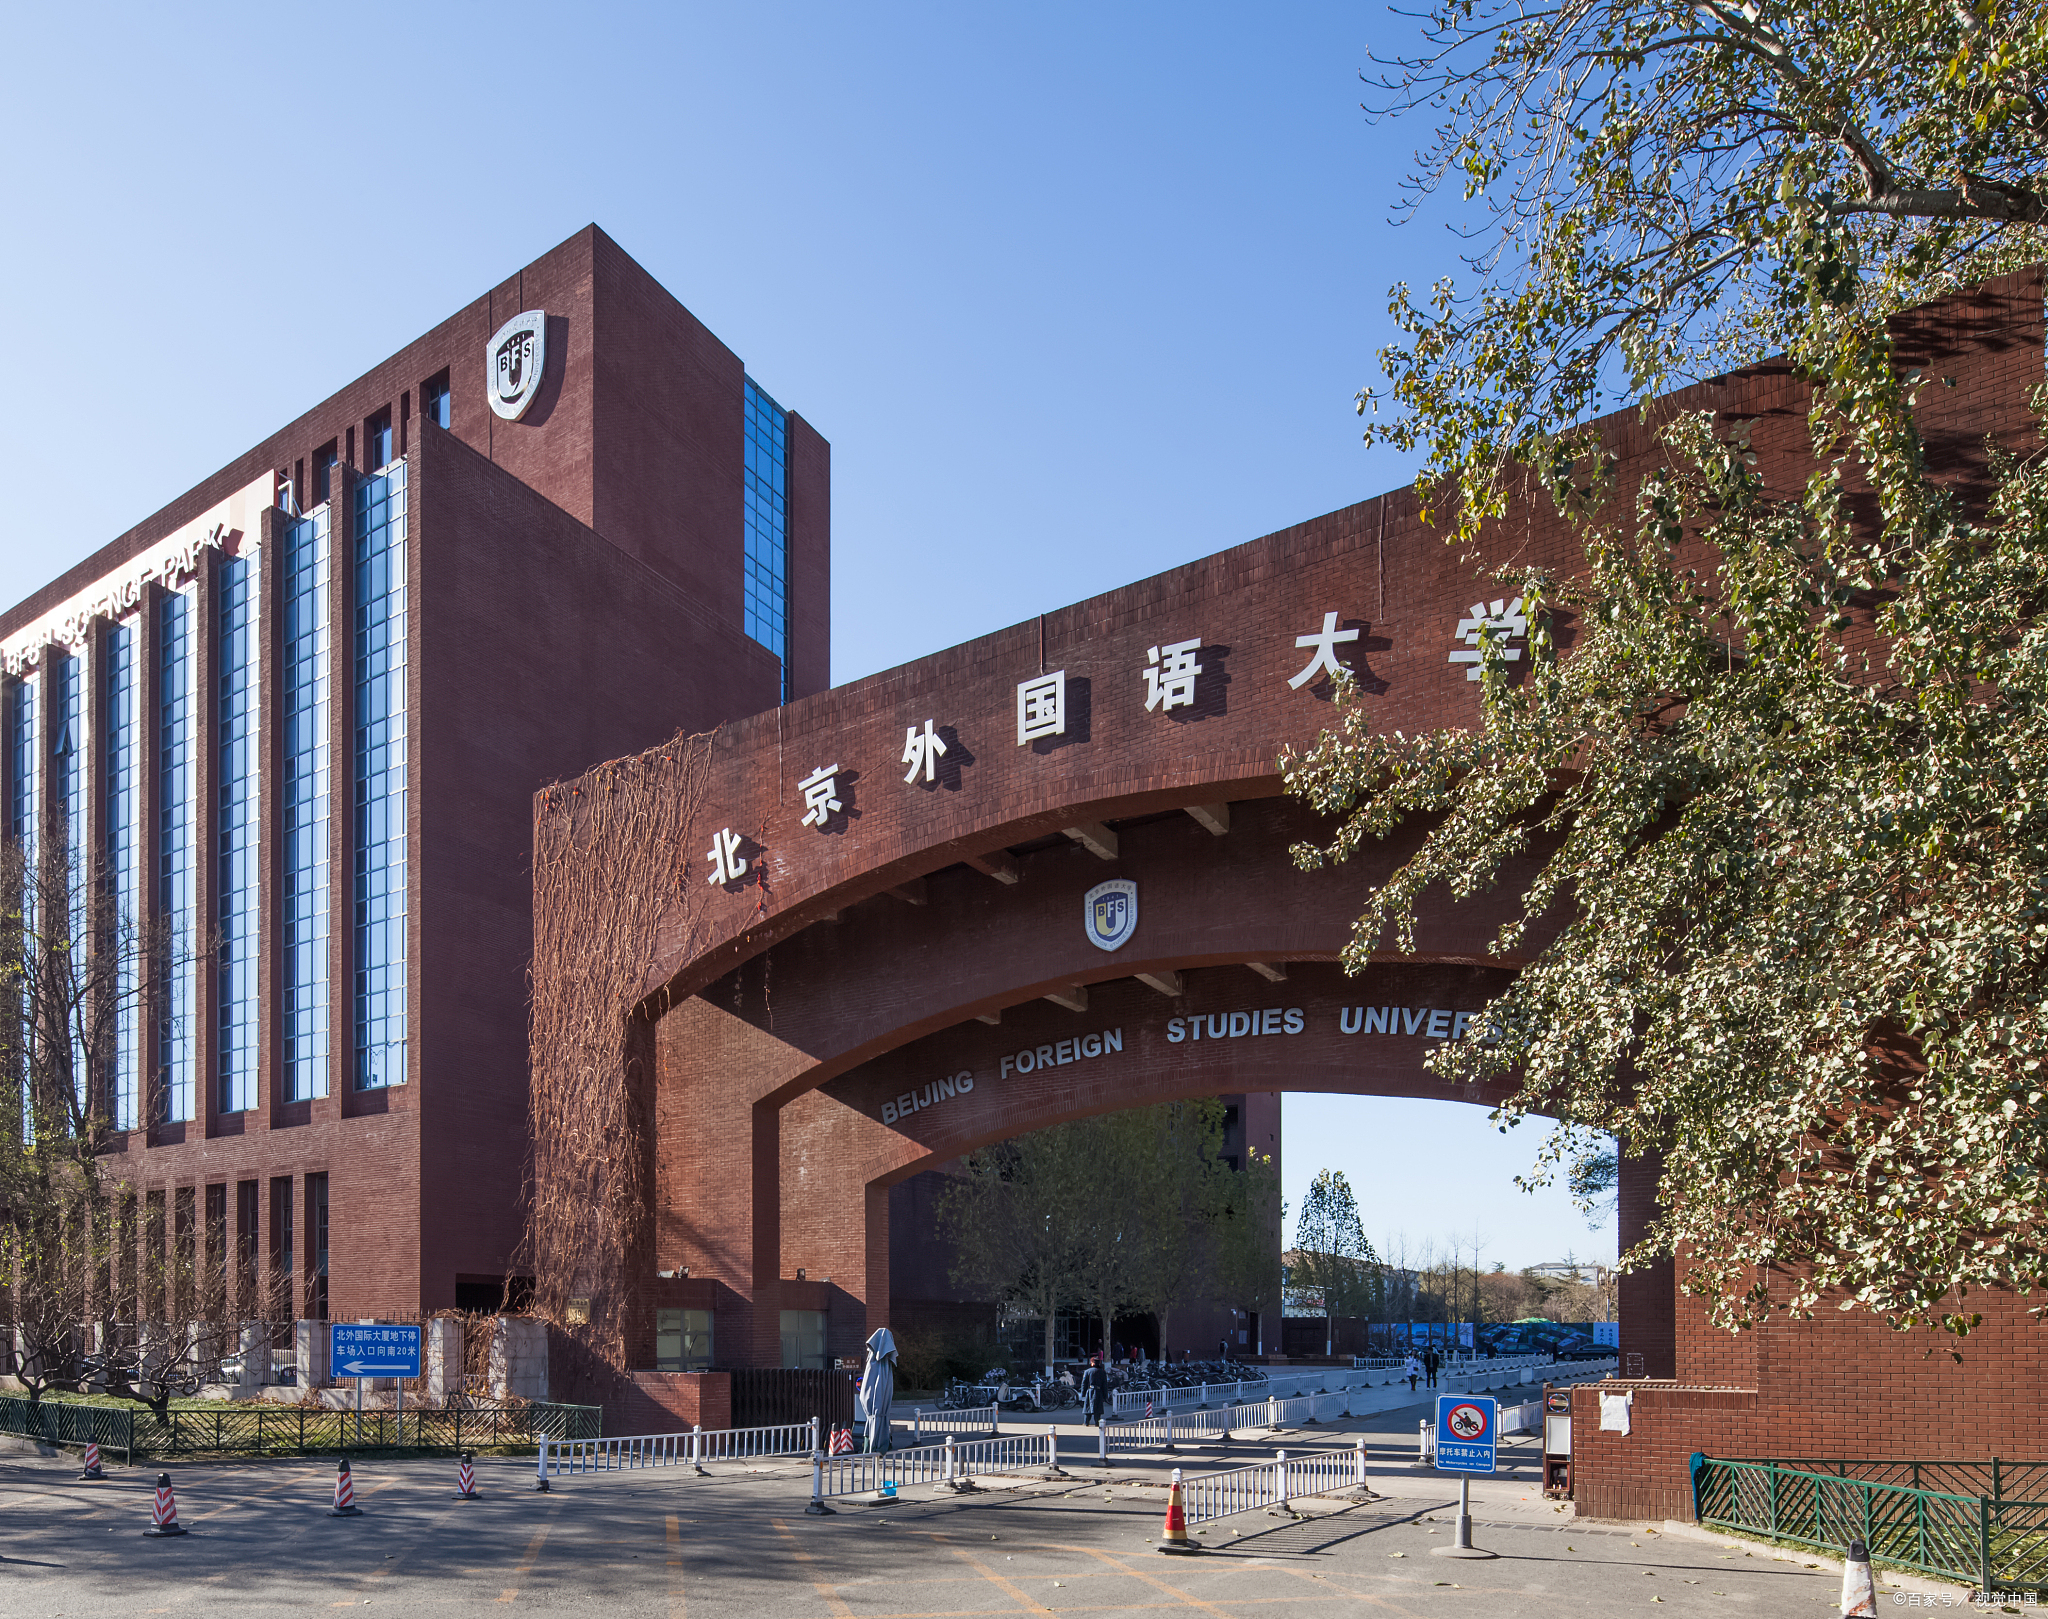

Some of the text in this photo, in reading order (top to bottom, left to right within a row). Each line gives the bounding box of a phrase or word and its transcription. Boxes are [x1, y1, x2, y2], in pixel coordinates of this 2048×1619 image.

[706, 597, 1526, 886] 北京外国语大学
[880, 1070, 974, 1126] BEIJING
[1000, 1028, 1123, 1080] FOREIGN
[1166, 1007, 1305, 1043] STUDIES
[336, 1329, 417, 1342] 北外国际大厦地下停
[336, 1345, 416, 1357] 车场入口向南20米
[1439, 1447, 1491, 1458] 摩托车禁止入内
